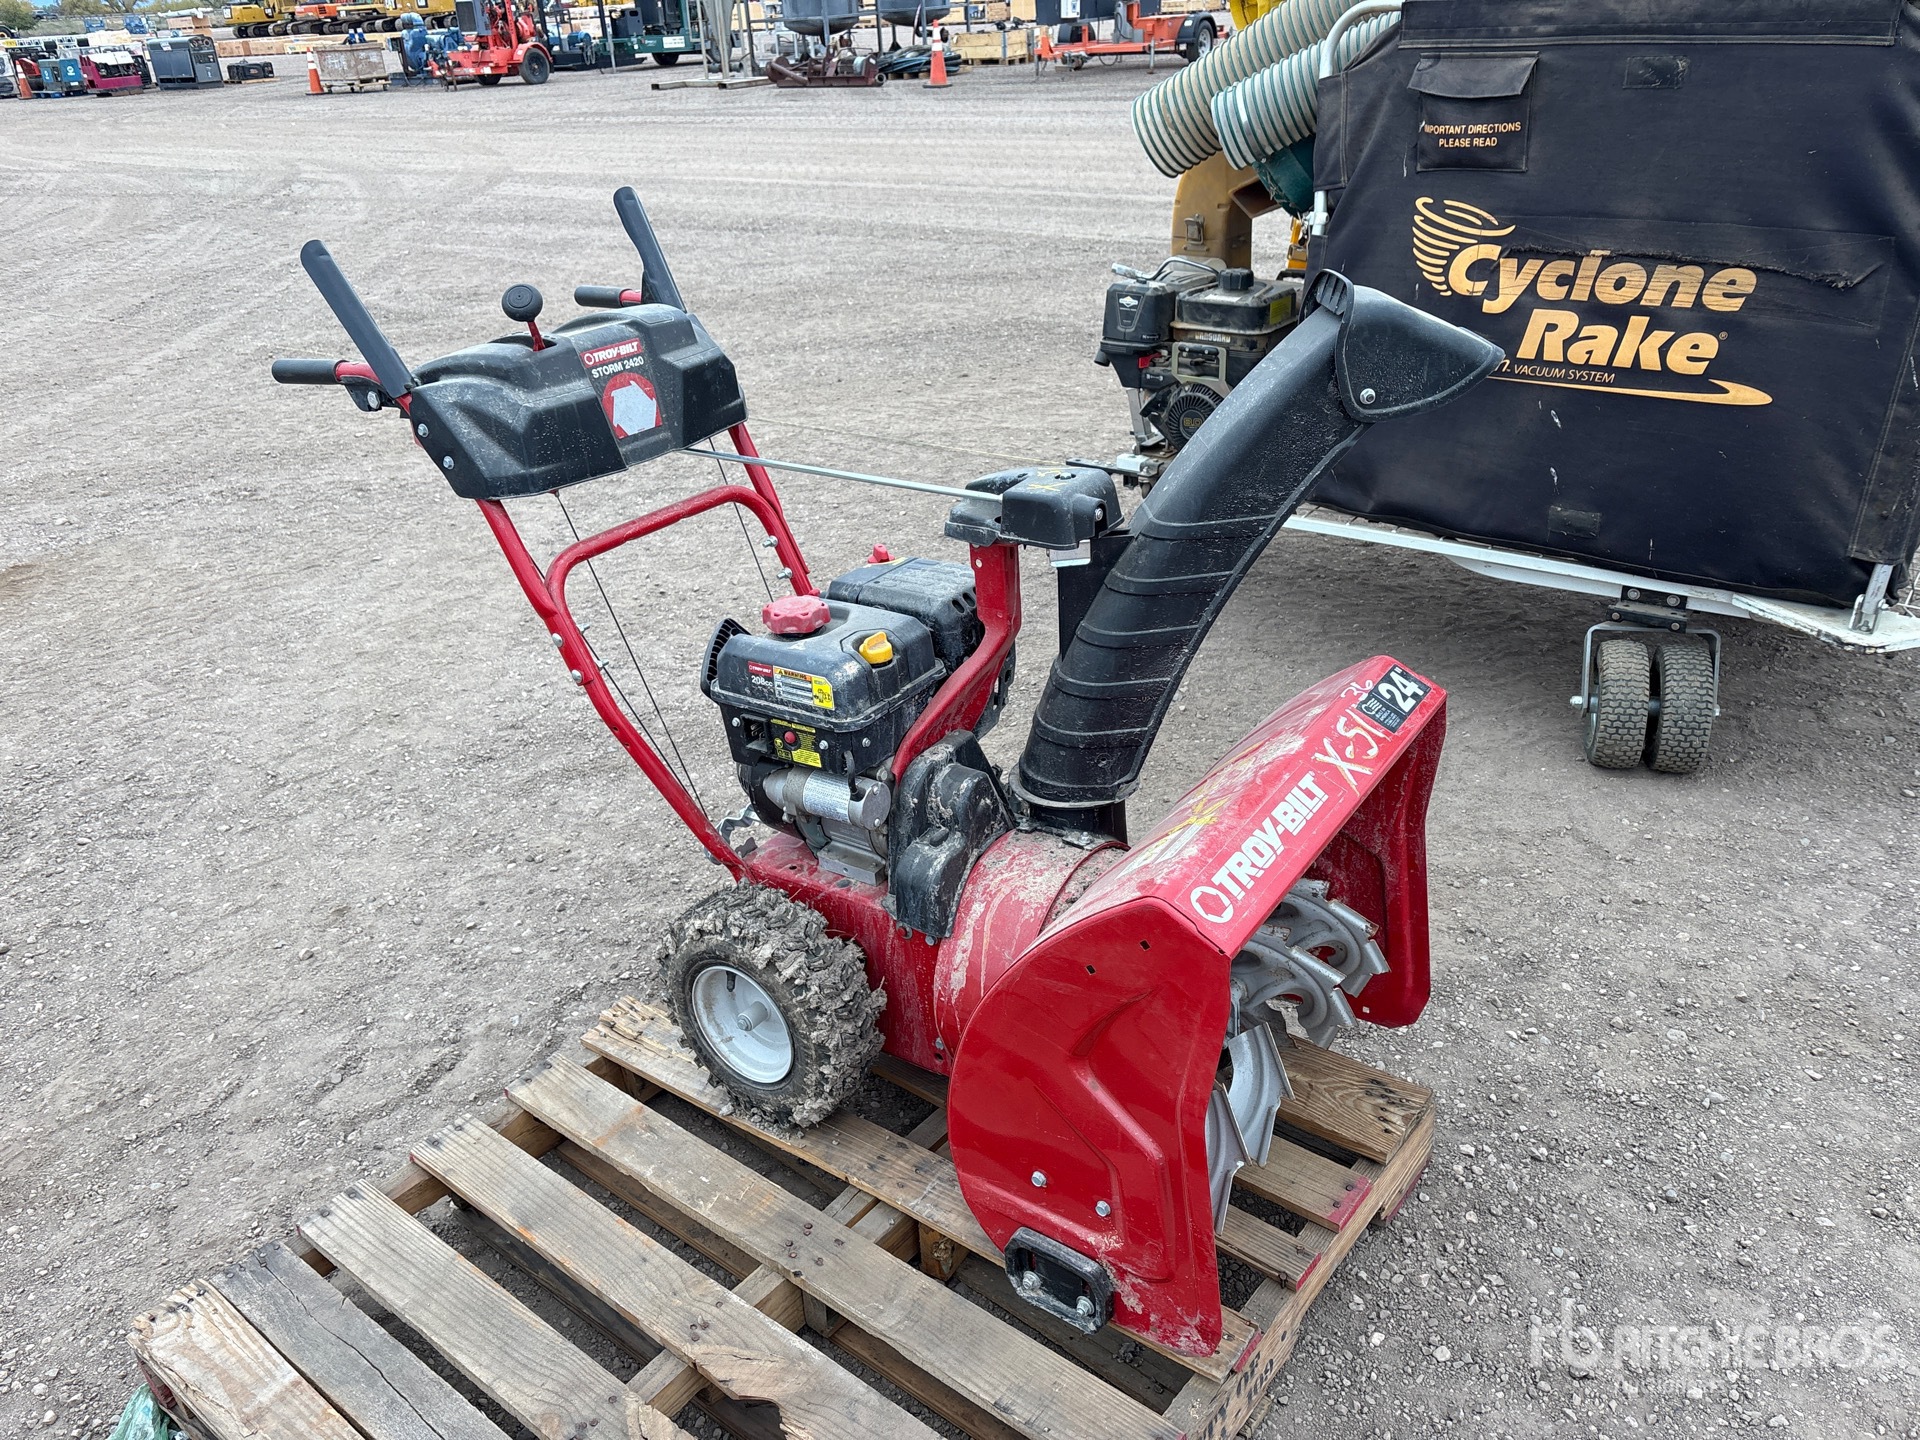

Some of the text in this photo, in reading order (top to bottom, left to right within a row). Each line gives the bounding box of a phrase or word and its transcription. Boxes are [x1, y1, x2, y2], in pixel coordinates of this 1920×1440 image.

[1467, 121, 1521, 134] DIRECTIONS
[1438, 137, 1498, 148] PLEASE READ
[1448, 243, 1758, 315] Cyclone
[592, 341, 639, 363] TROY-BILT
[591, 356, 645, 379] STORM 2420
[1514, 364, 1566, 379] VACUUM
[1567, 369, 1616, 384] SYSTEM
[751, 674, 774, 688] 208cc
